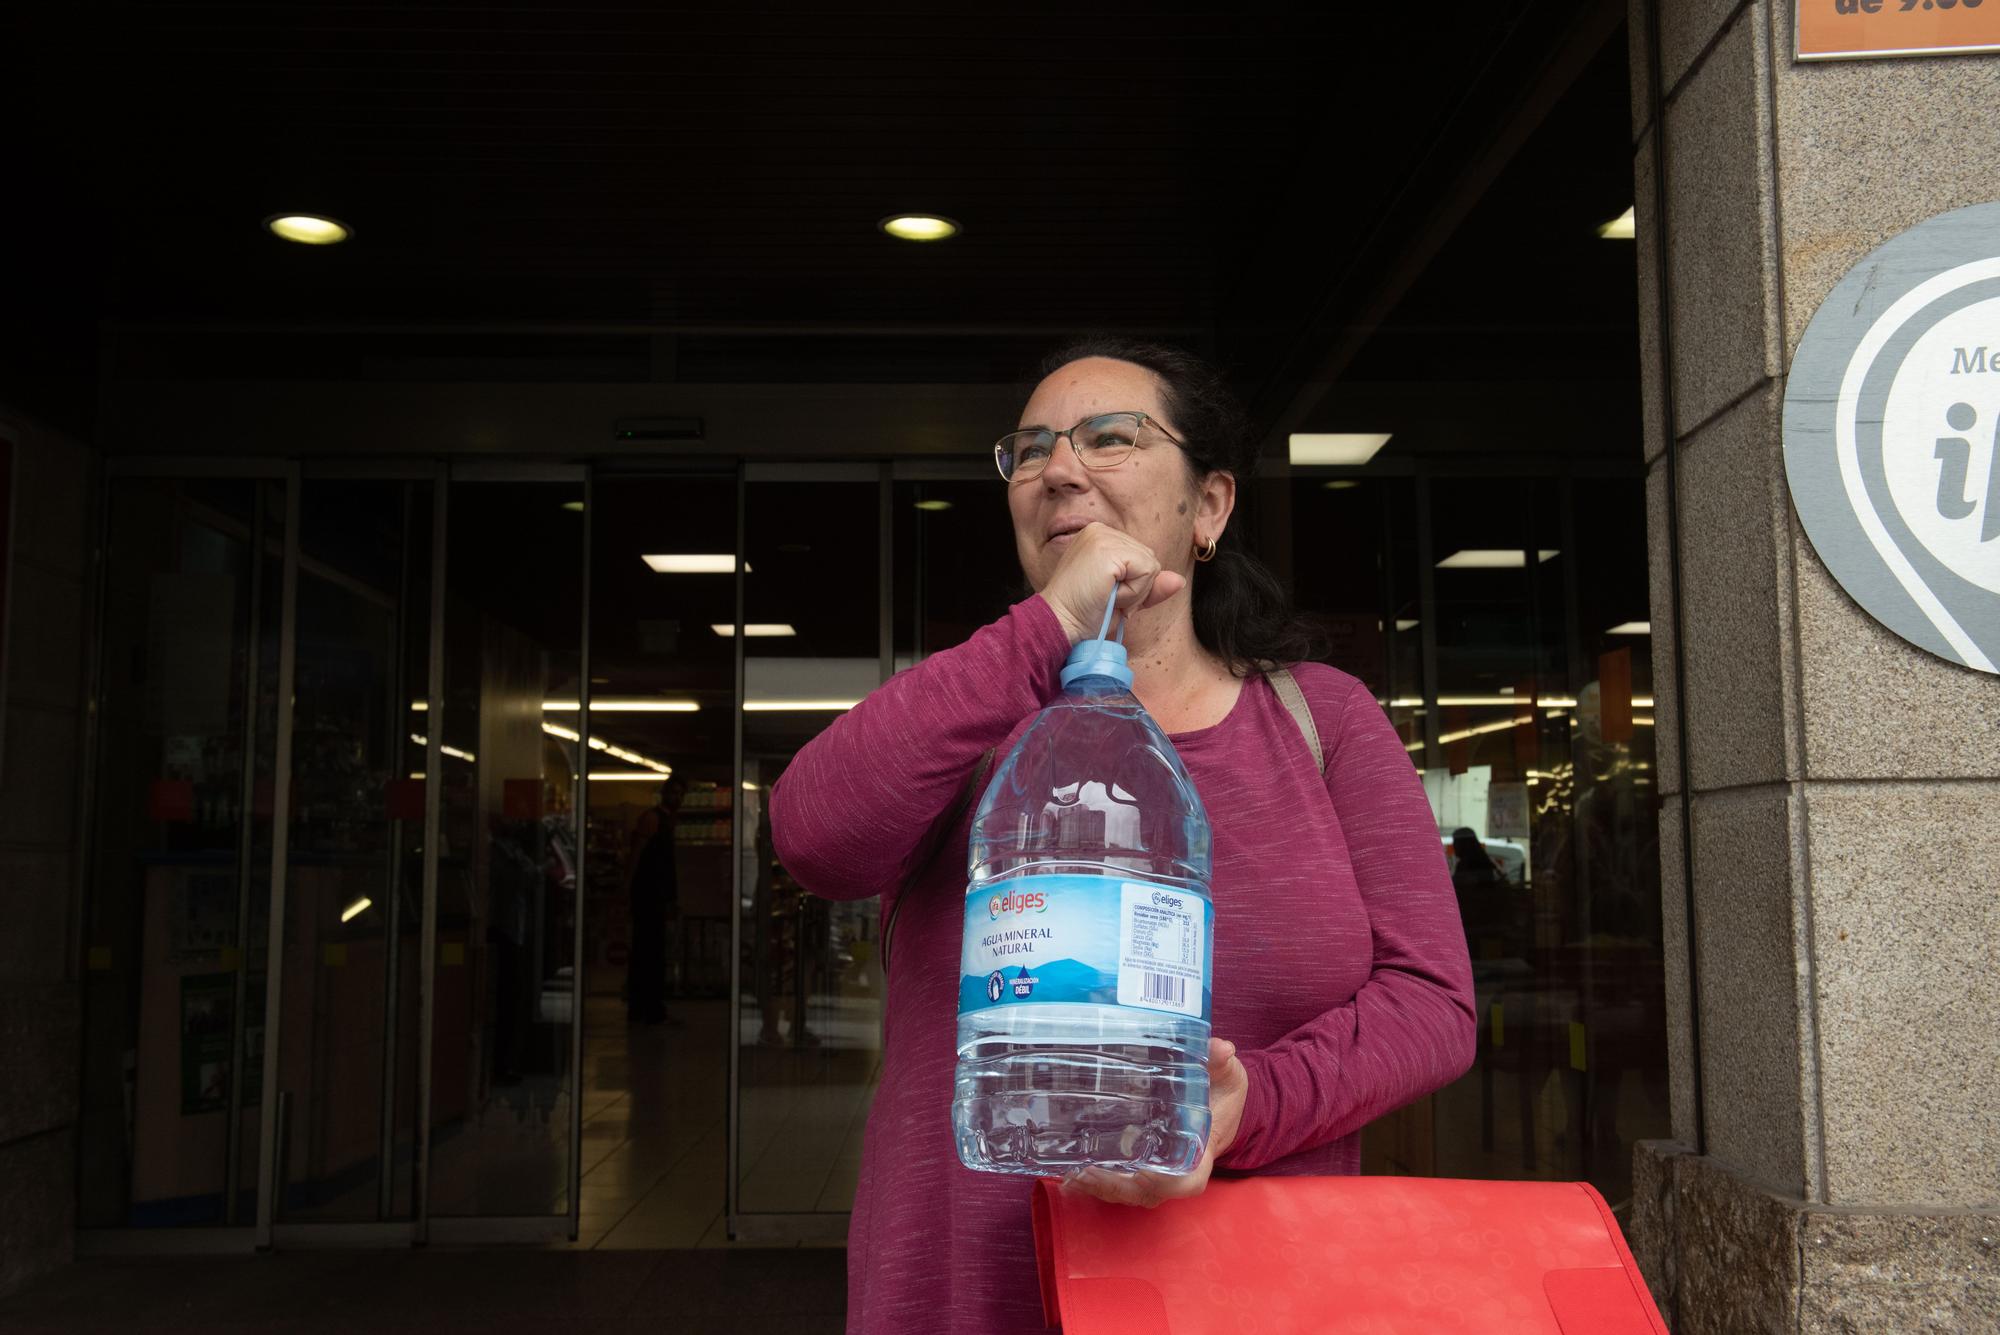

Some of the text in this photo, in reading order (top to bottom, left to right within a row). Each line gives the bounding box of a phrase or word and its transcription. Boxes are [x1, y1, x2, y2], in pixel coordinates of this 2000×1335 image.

[1001, 889, 1045, 914] eliges
[1161, 894, 1182, 908] eliges
[982, 927, 1053, 948] AGUA MINERAL
[992, 941, 1035, 957] NATURAL
